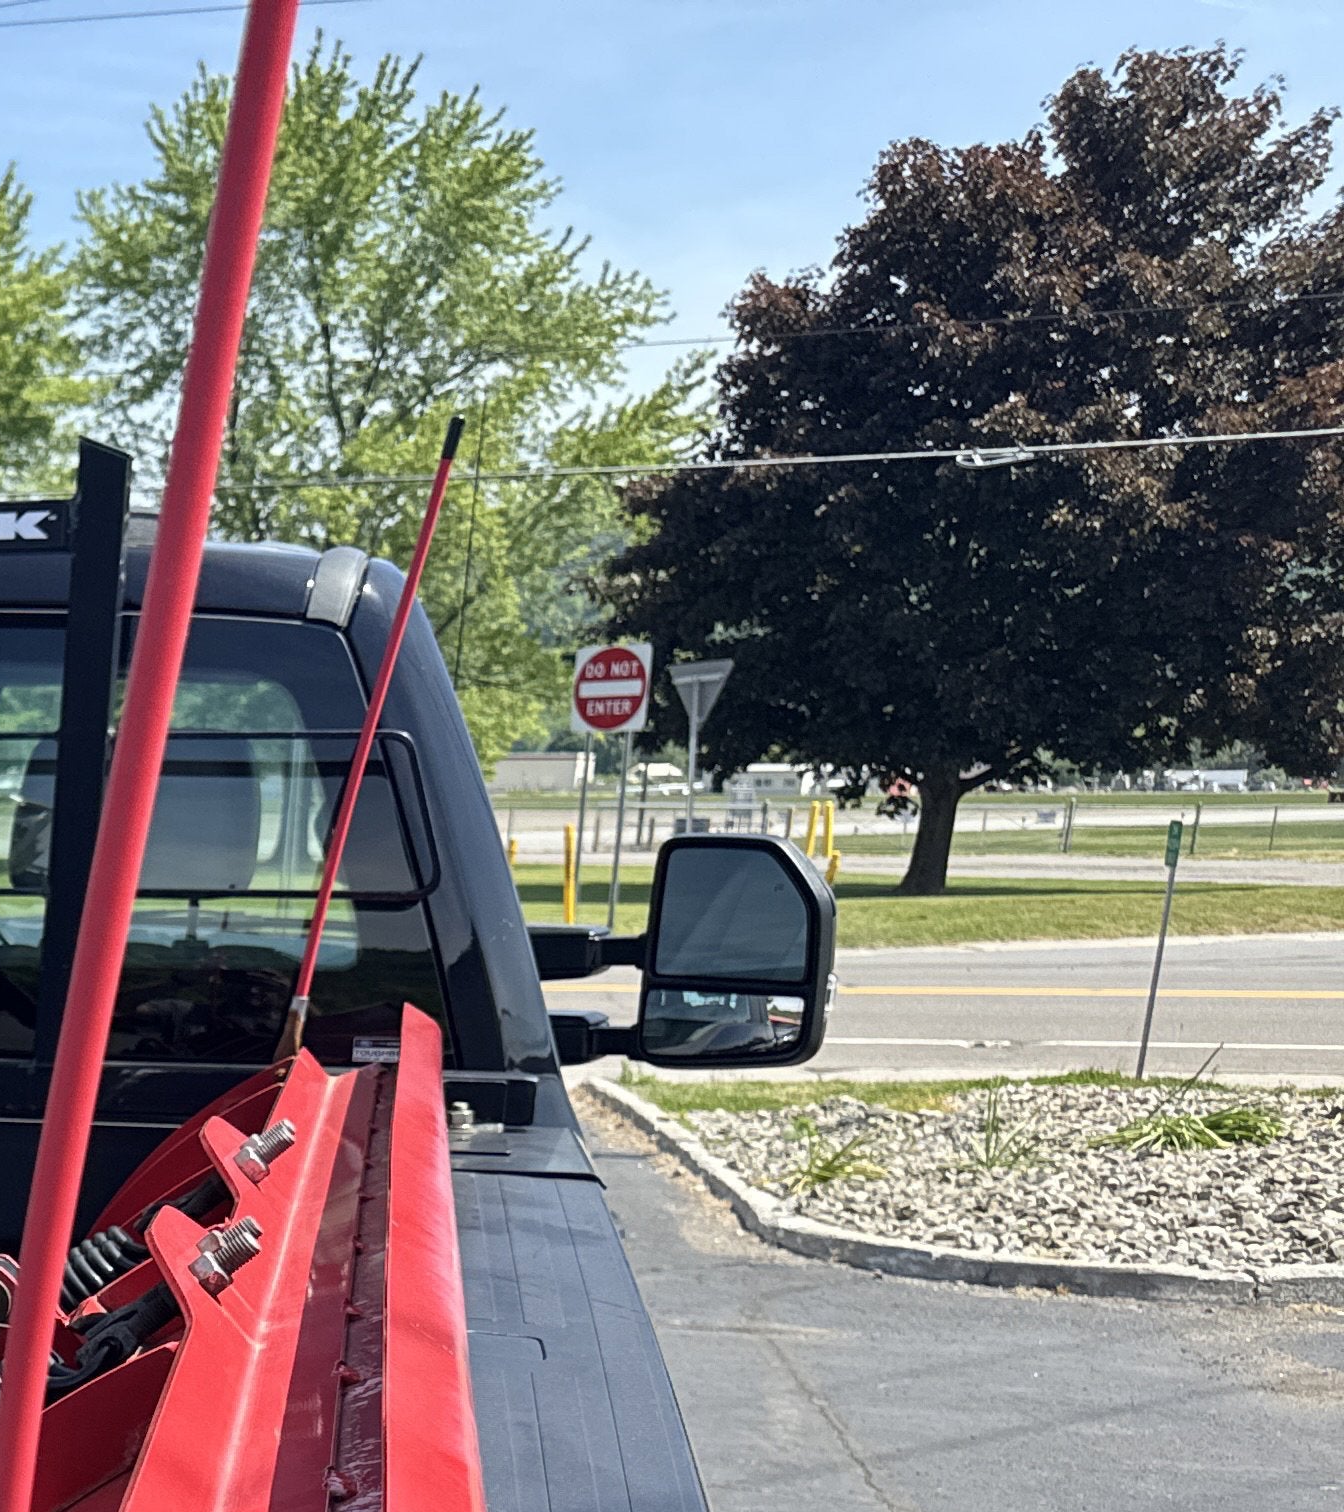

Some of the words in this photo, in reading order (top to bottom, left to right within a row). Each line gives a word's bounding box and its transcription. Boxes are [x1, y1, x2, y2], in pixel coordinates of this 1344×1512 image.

[585, 662, 606, 678] DO
[610, 660, 639, 677] NOT
[586, 699, 632, 716] ENTER
